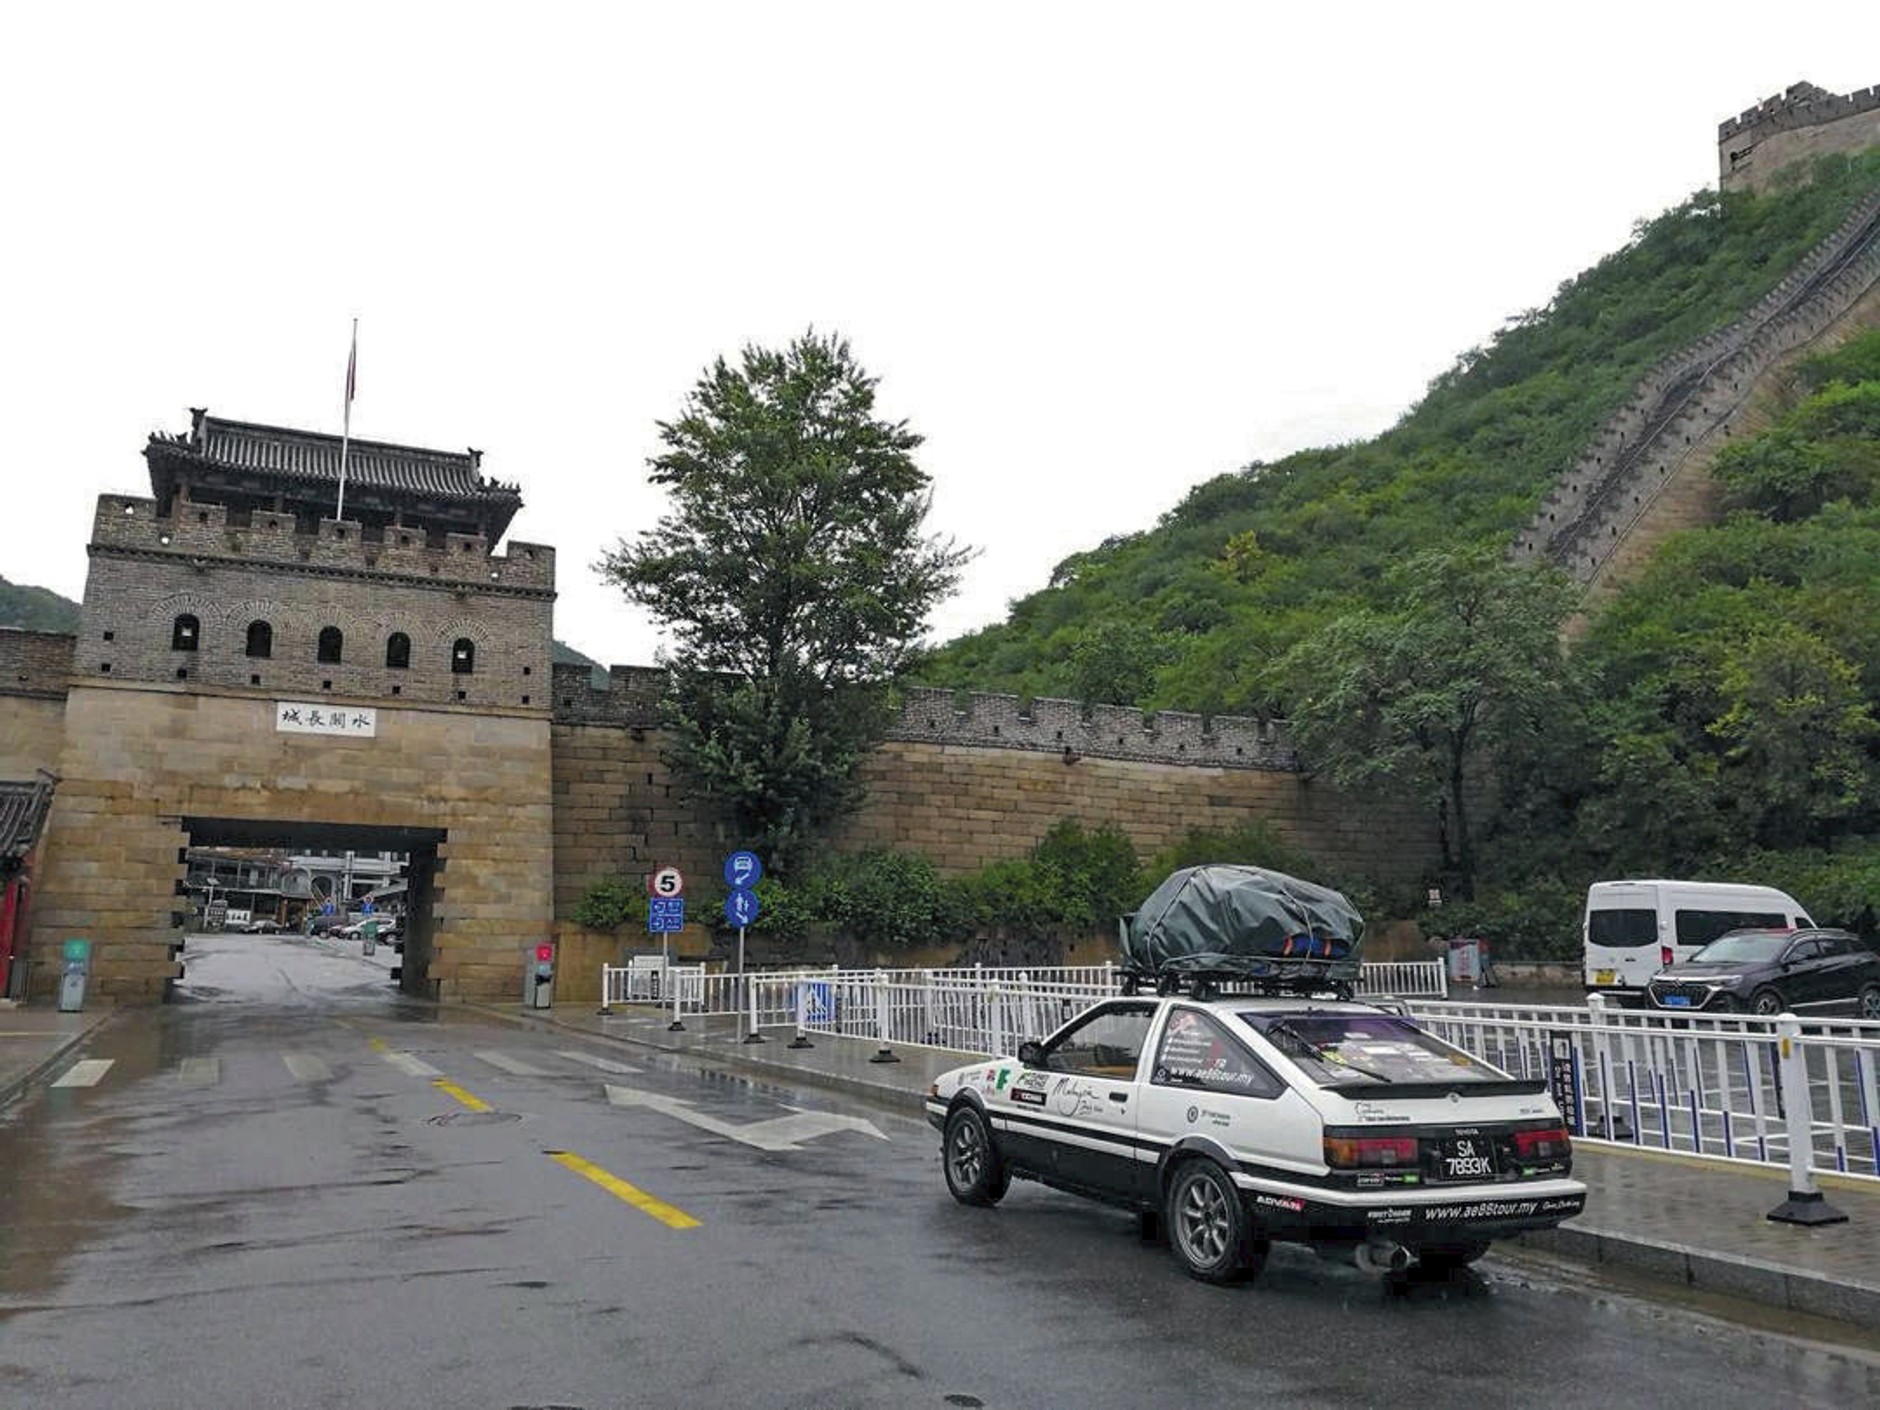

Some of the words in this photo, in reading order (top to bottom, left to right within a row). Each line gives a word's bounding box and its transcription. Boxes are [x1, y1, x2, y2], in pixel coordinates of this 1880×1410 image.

[661, 875, 675, 892] 5
[1457, 1140, 1475, 1157] SA
[1445, 1157, 1492, 1176] 7893K
[1257, 1196, 1301, 1211] ADVAN
